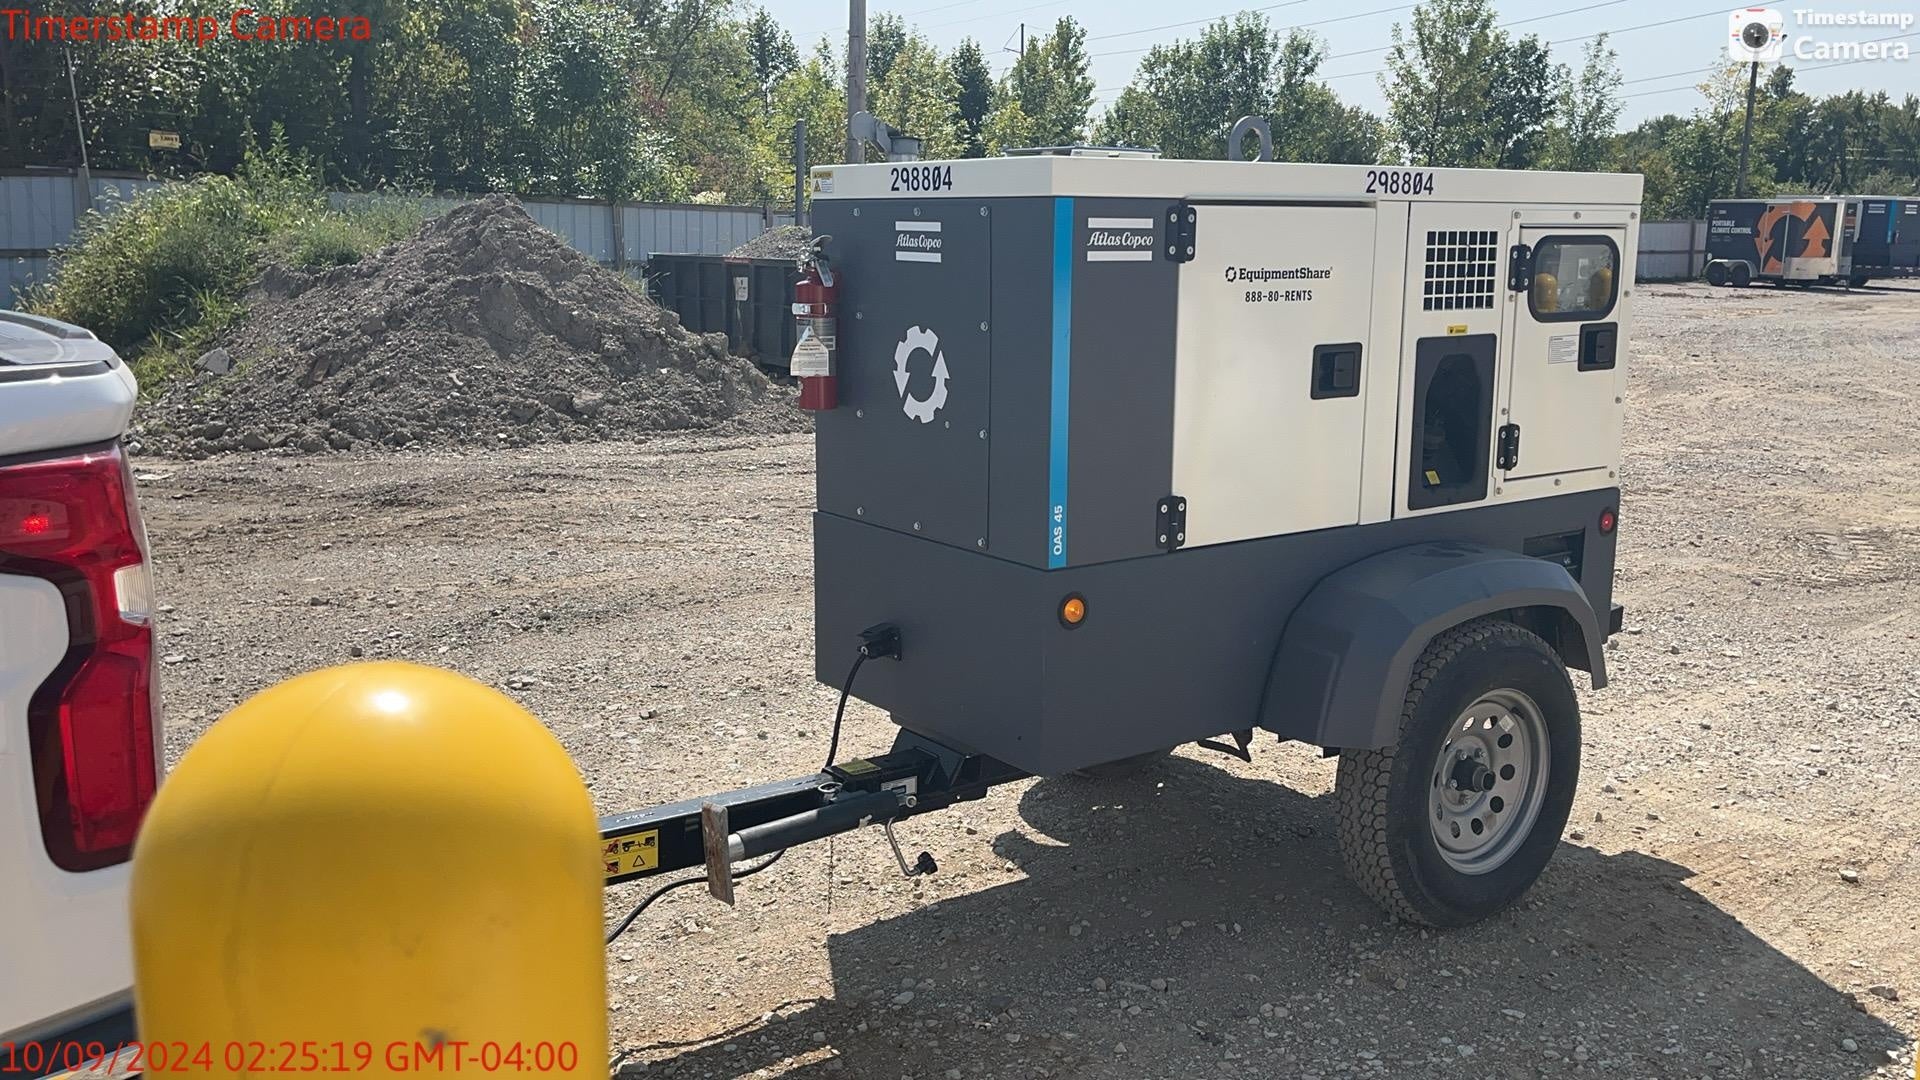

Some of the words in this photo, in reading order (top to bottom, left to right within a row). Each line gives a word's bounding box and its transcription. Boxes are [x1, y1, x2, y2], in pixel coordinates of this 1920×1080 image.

[890, 165, 952, 191] 298804
[1366, 170, 1434, 195] 298804
[896, 233, 918, 248] Atlas
[918, 234, 942, 250] Copco
[1087, 231, 1121, 246] Atlas
[1121, 231, 1153, 249] Copco
[1238, 267, 1331, 282] EquipmentShare
[1245, 290, 1313, 303] 888-80-RENTS
[1054, 504, 1063, 523] 45
